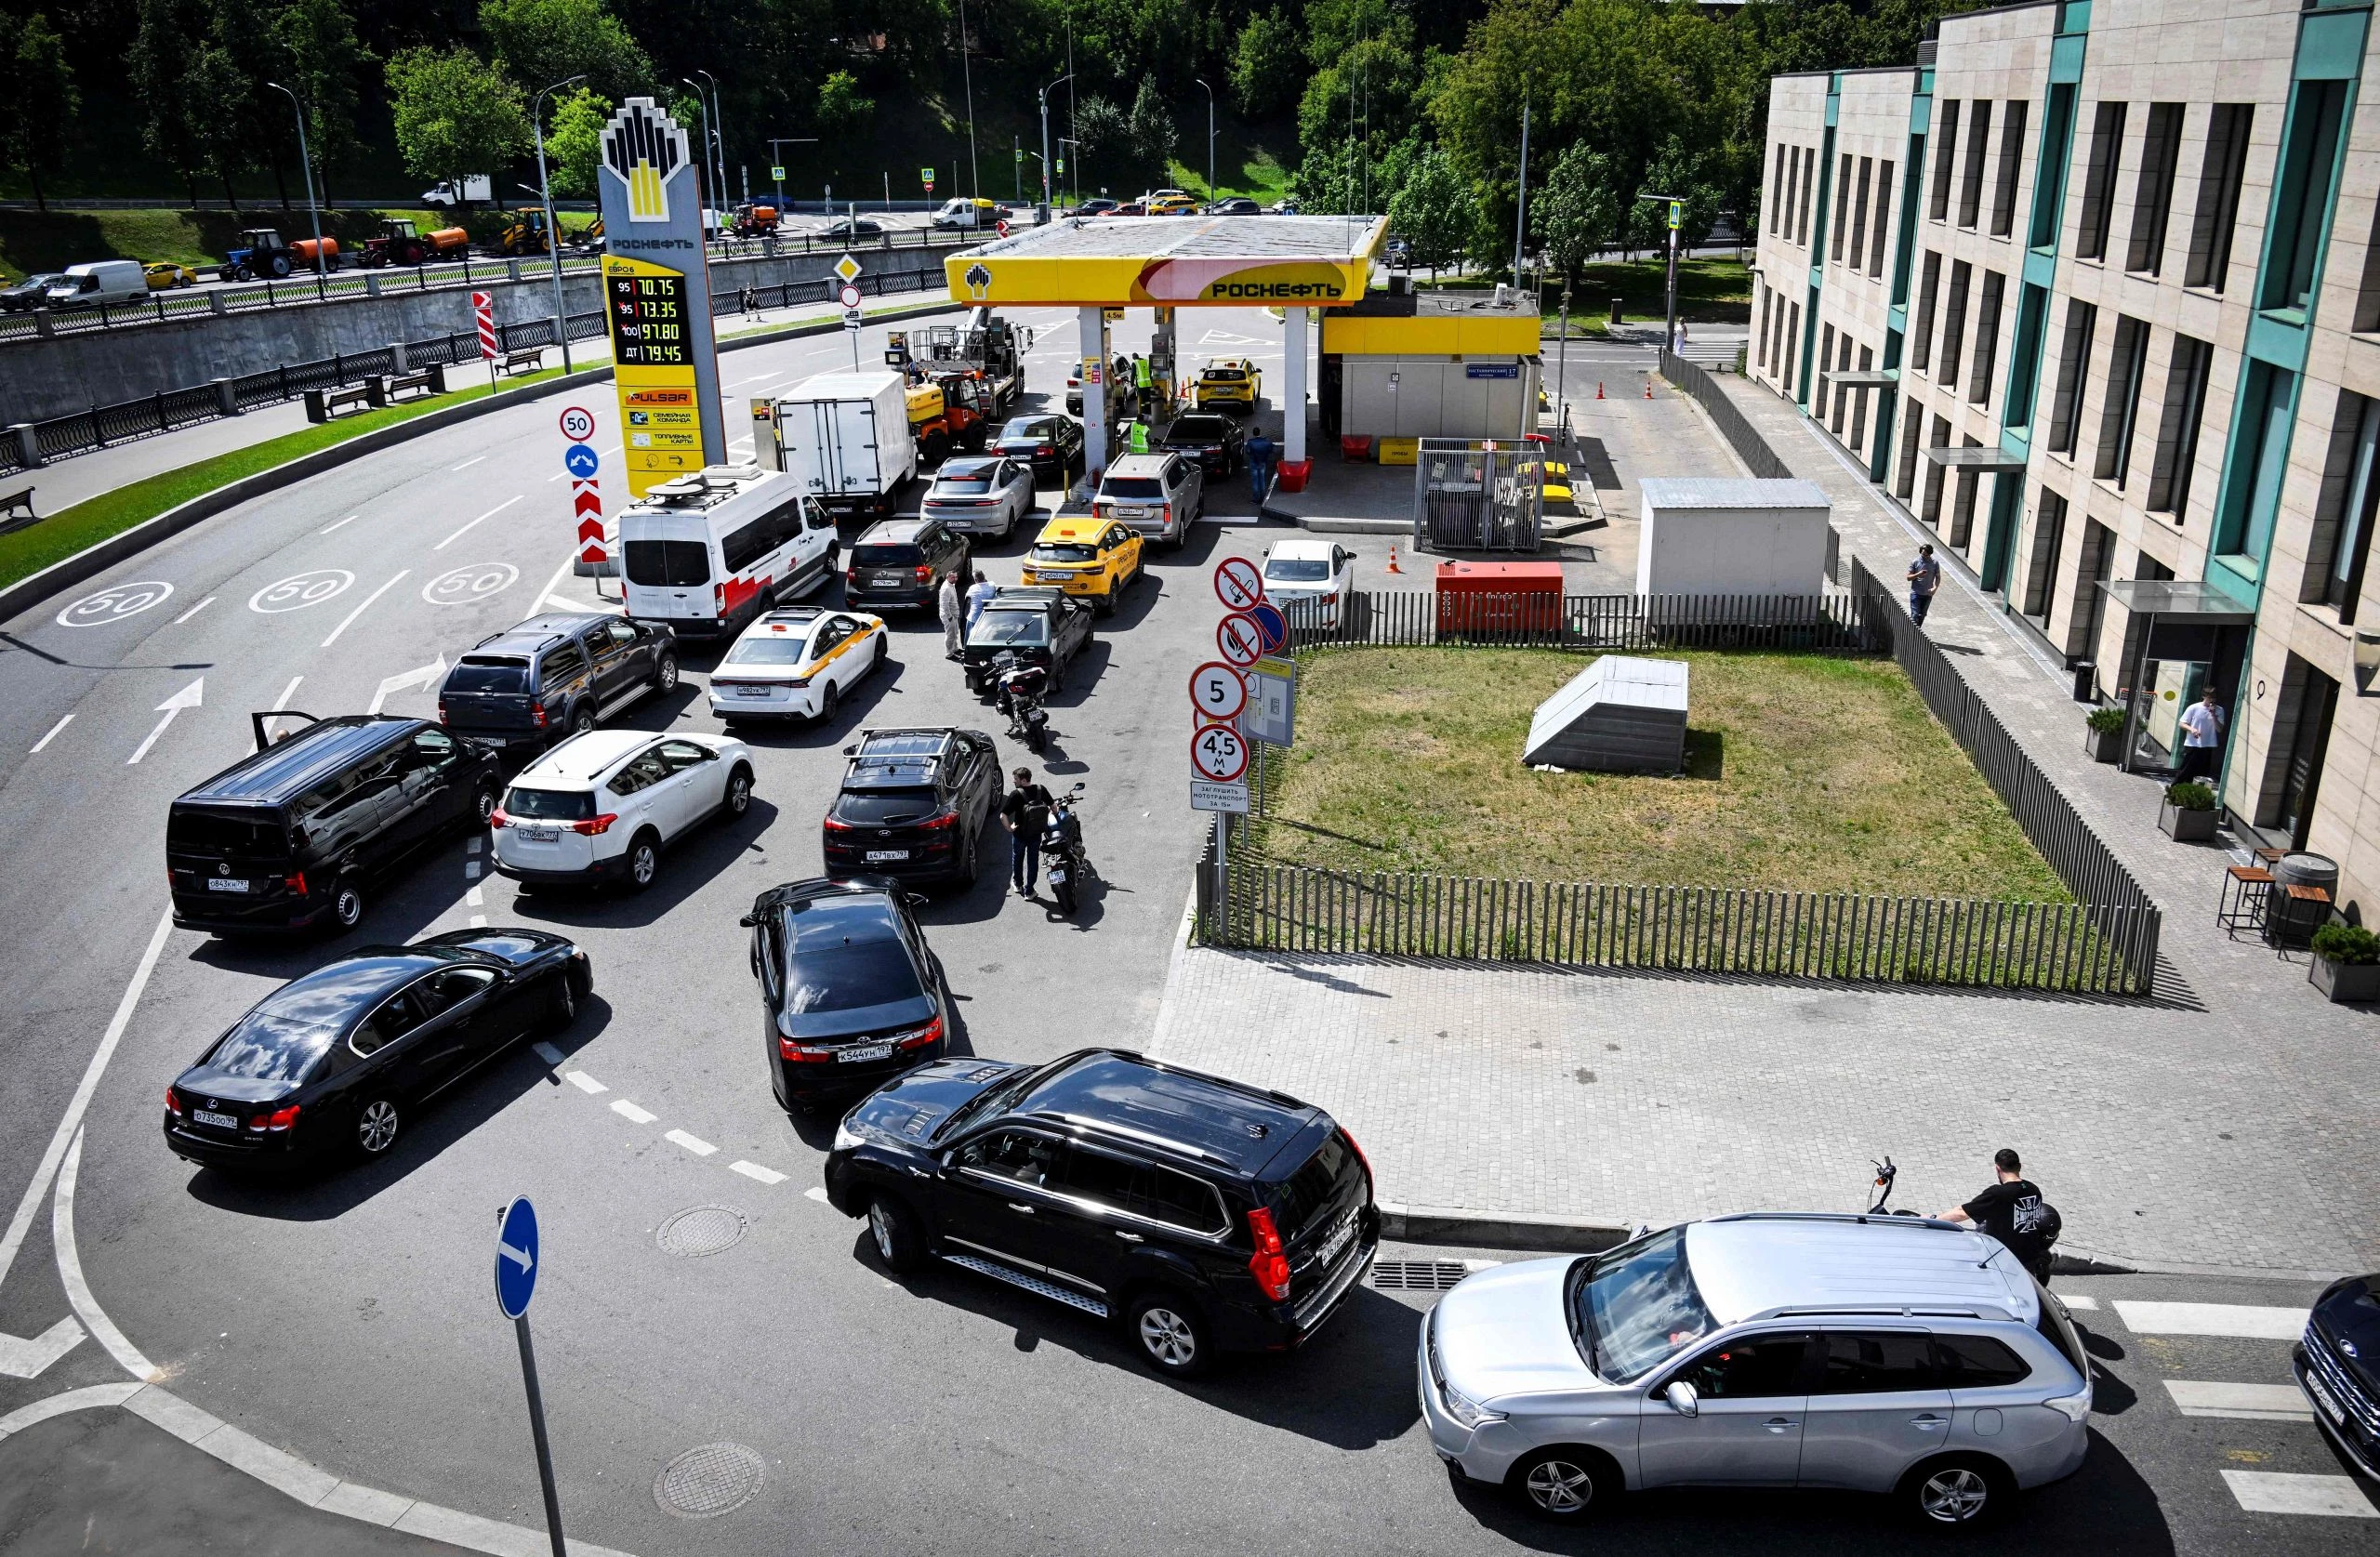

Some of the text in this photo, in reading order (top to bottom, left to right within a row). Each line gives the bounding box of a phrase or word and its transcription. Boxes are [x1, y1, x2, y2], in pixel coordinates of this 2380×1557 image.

[612, 239, 694, 249] РОСНЕФТЬ
[618, 279, 674, 295] 95 70.75
[1212, 283, 1342, 297] РОСНЕФТЬ
[621, 301, 677, 317] 95 73.35
[623, 323, 680, 339] 100 97.80
[626, 345, 681, 361] ДТ 79.45
[630, 393, 688, 402] PULSAR
[567, 417, 587, 430] 50
[268, 579, 337, 601] 50
[438, 572, 504, 593] 50
[78, 591, 154, 614] 50
[1210, 680, 1224, 703] 5
[1203, 735, 1236, 757] 4,5
[1193, 793, 1247, 801] МОТОТРАНСПОРТ
